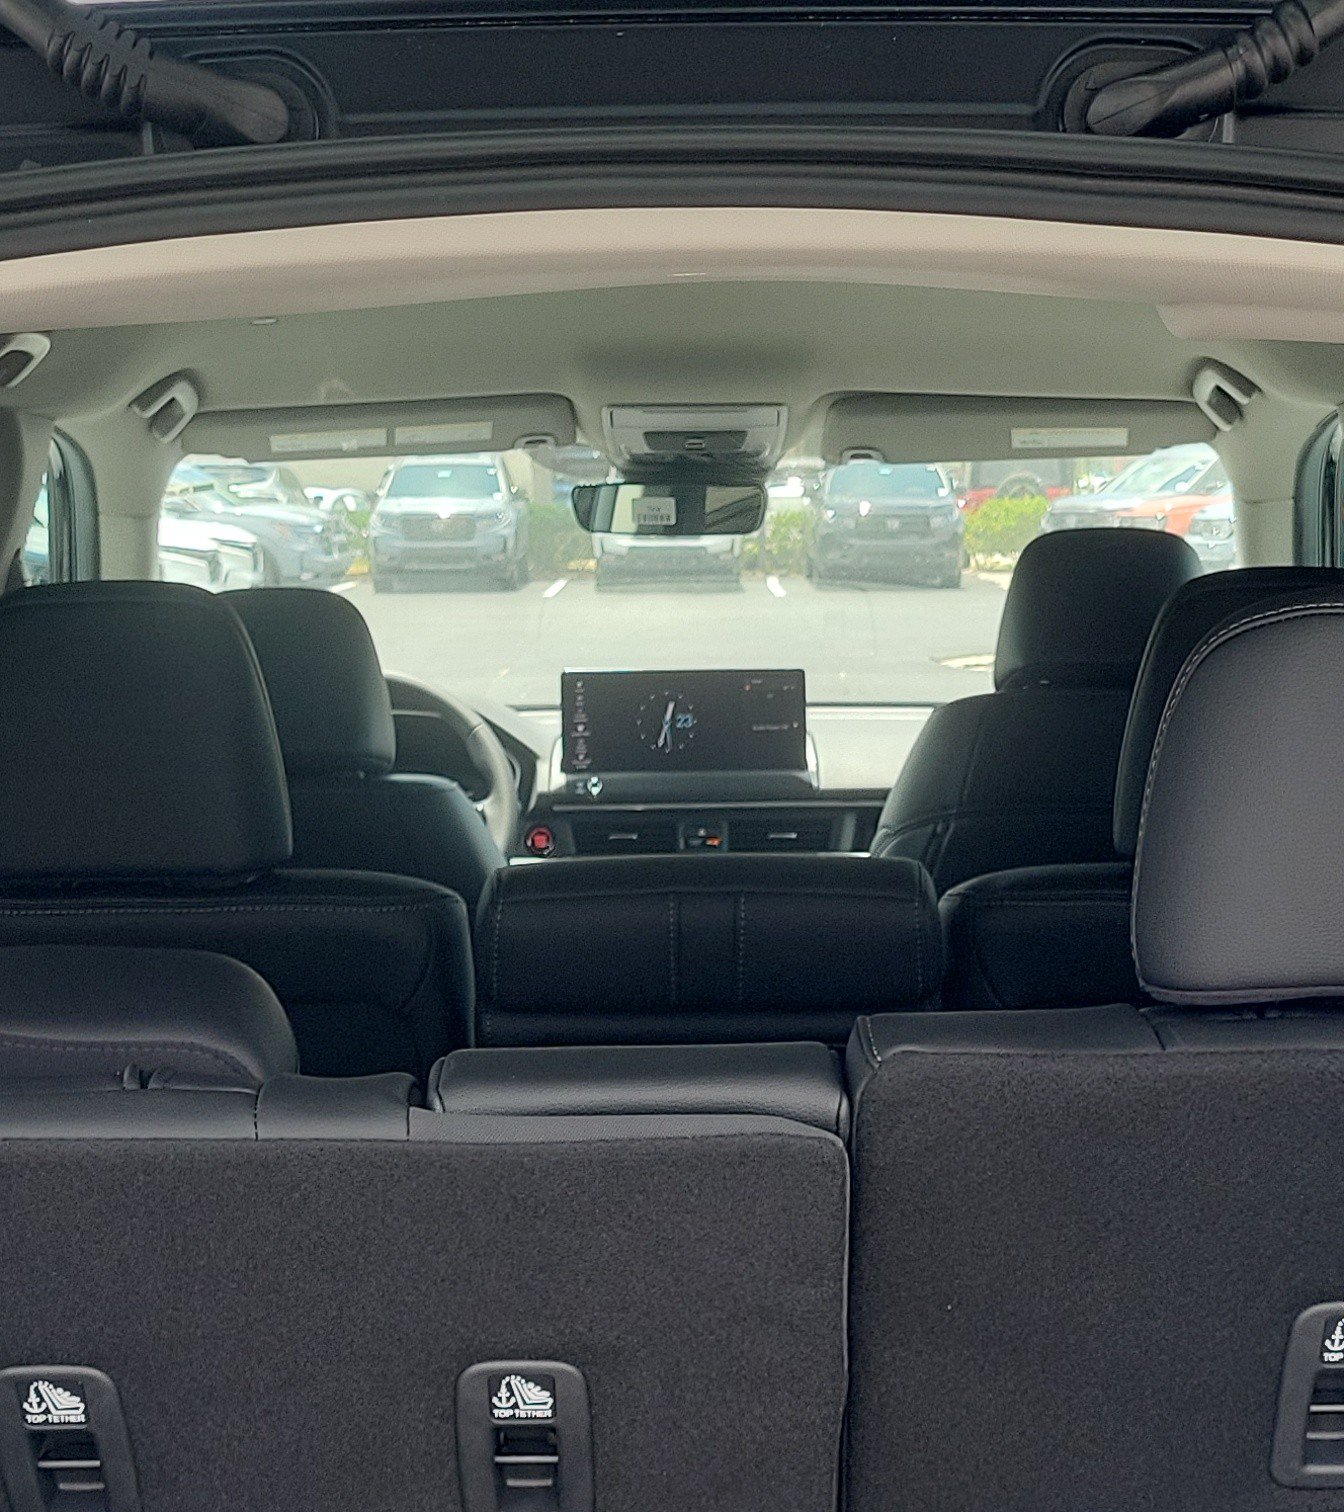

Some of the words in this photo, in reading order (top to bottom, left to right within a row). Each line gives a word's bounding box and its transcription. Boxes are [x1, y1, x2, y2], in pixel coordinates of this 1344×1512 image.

[1323, 1352, 1344, 1362] TOP
[493, 1409, 514, 1418] TOP
[514, 1409, 552, 1418] TETHER
[25, 1414, 47, 1423] TOP
[47, 1414, 86, 1423] TETHER
